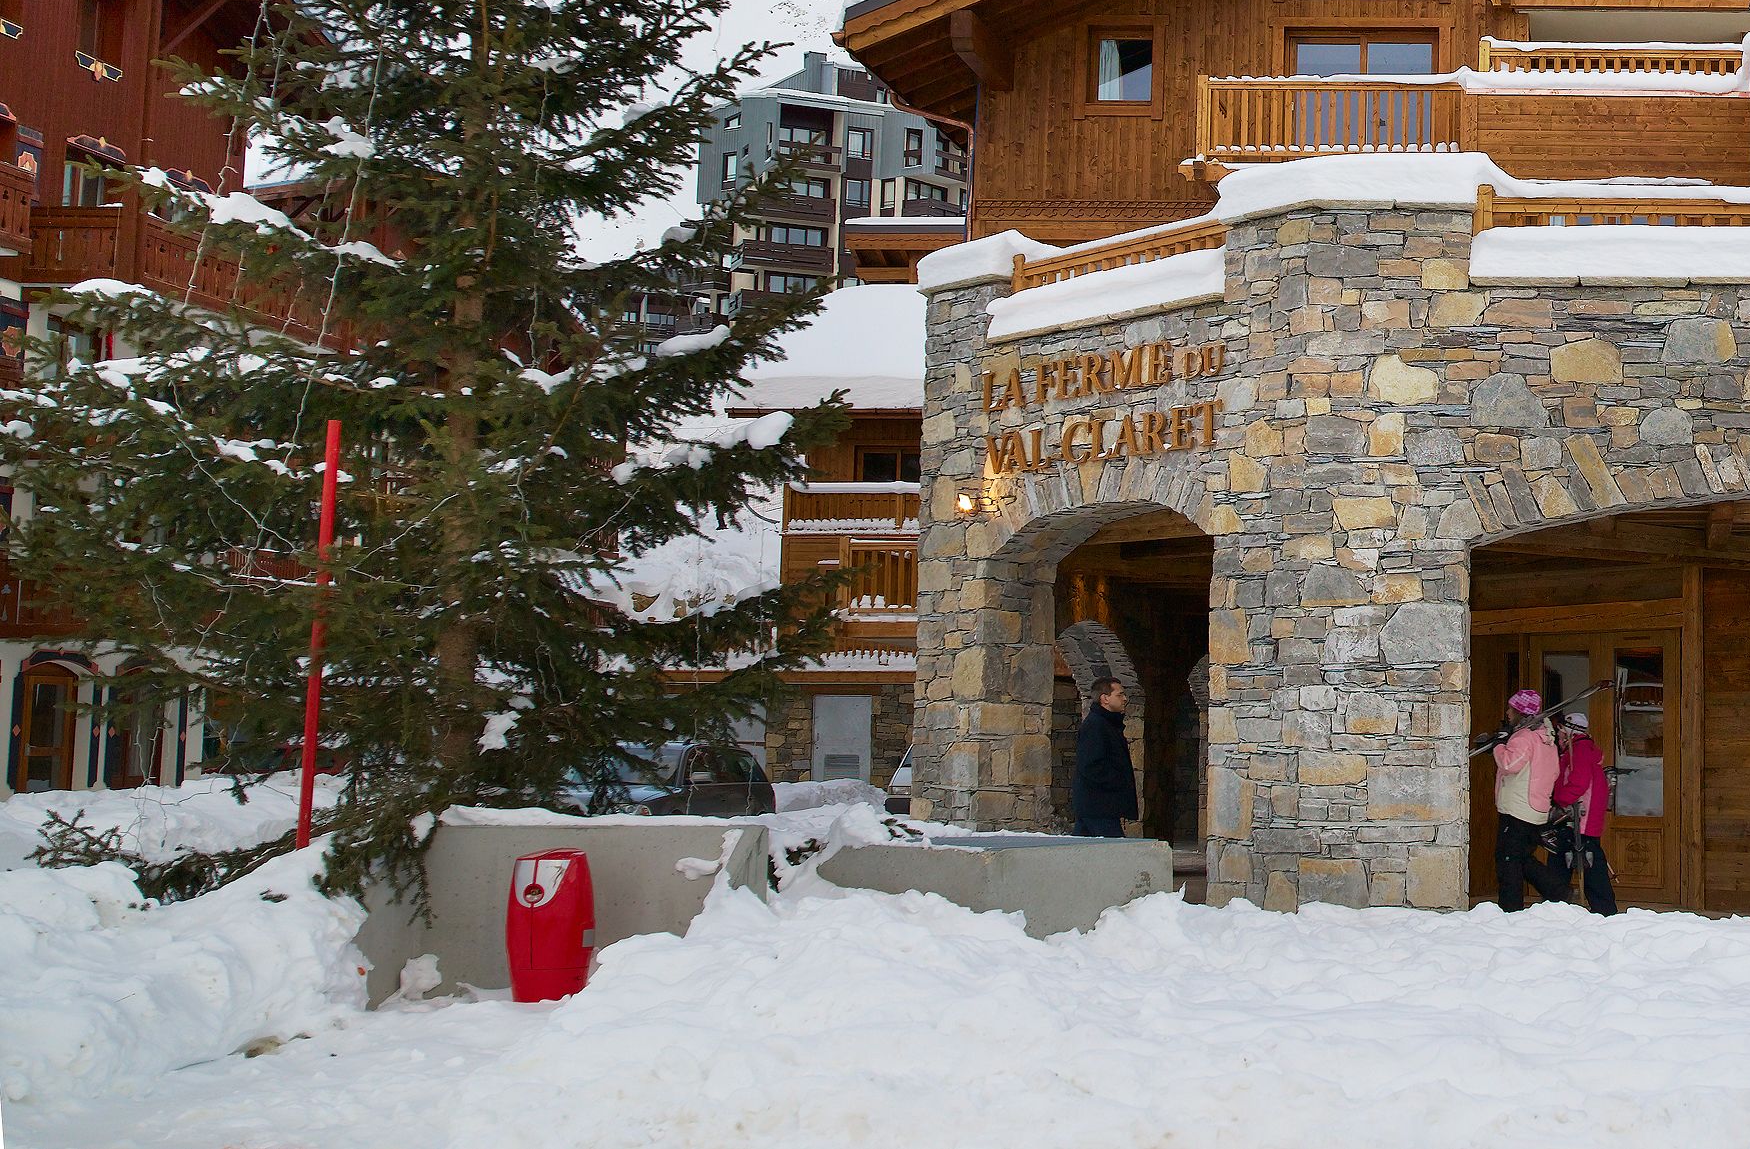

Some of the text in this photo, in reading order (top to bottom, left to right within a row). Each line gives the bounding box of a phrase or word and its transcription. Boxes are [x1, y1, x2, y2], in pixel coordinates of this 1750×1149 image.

[982, 342, 1226, 412] LA FERME DU
[986, 399, 1225, 474] VAL CLARET
